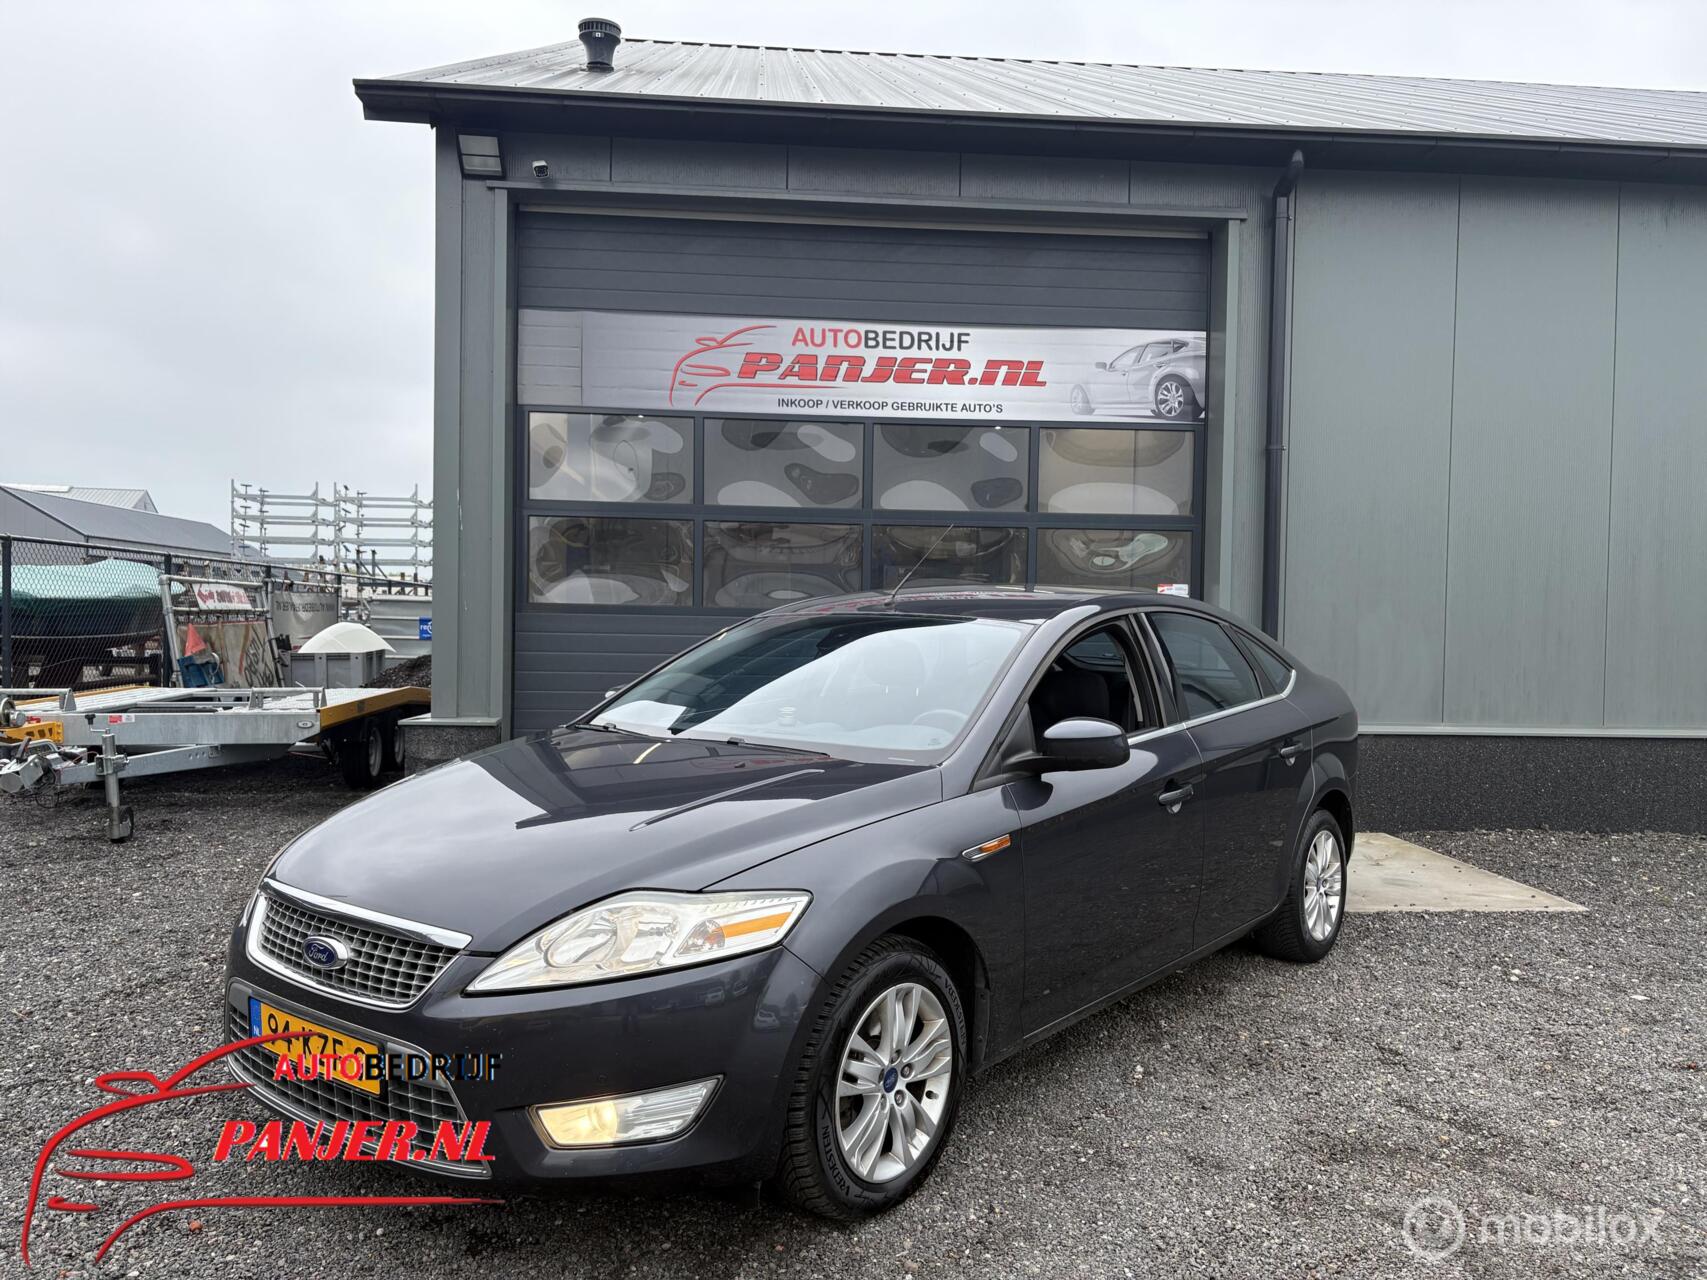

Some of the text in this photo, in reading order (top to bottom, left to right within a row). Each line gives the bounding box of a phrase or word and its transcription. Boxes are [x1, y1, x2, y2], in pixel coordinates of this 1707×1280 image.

[791, 327, 971, 352] AUTOBEDRIJF
[777, 398, 1004, 414] INKOOP / VERKOOP GEBRUIKTE AUTO'S
[308, 943, 329, 962] Ford
[821, 1124, 851, 1197] VREDESTEIN
